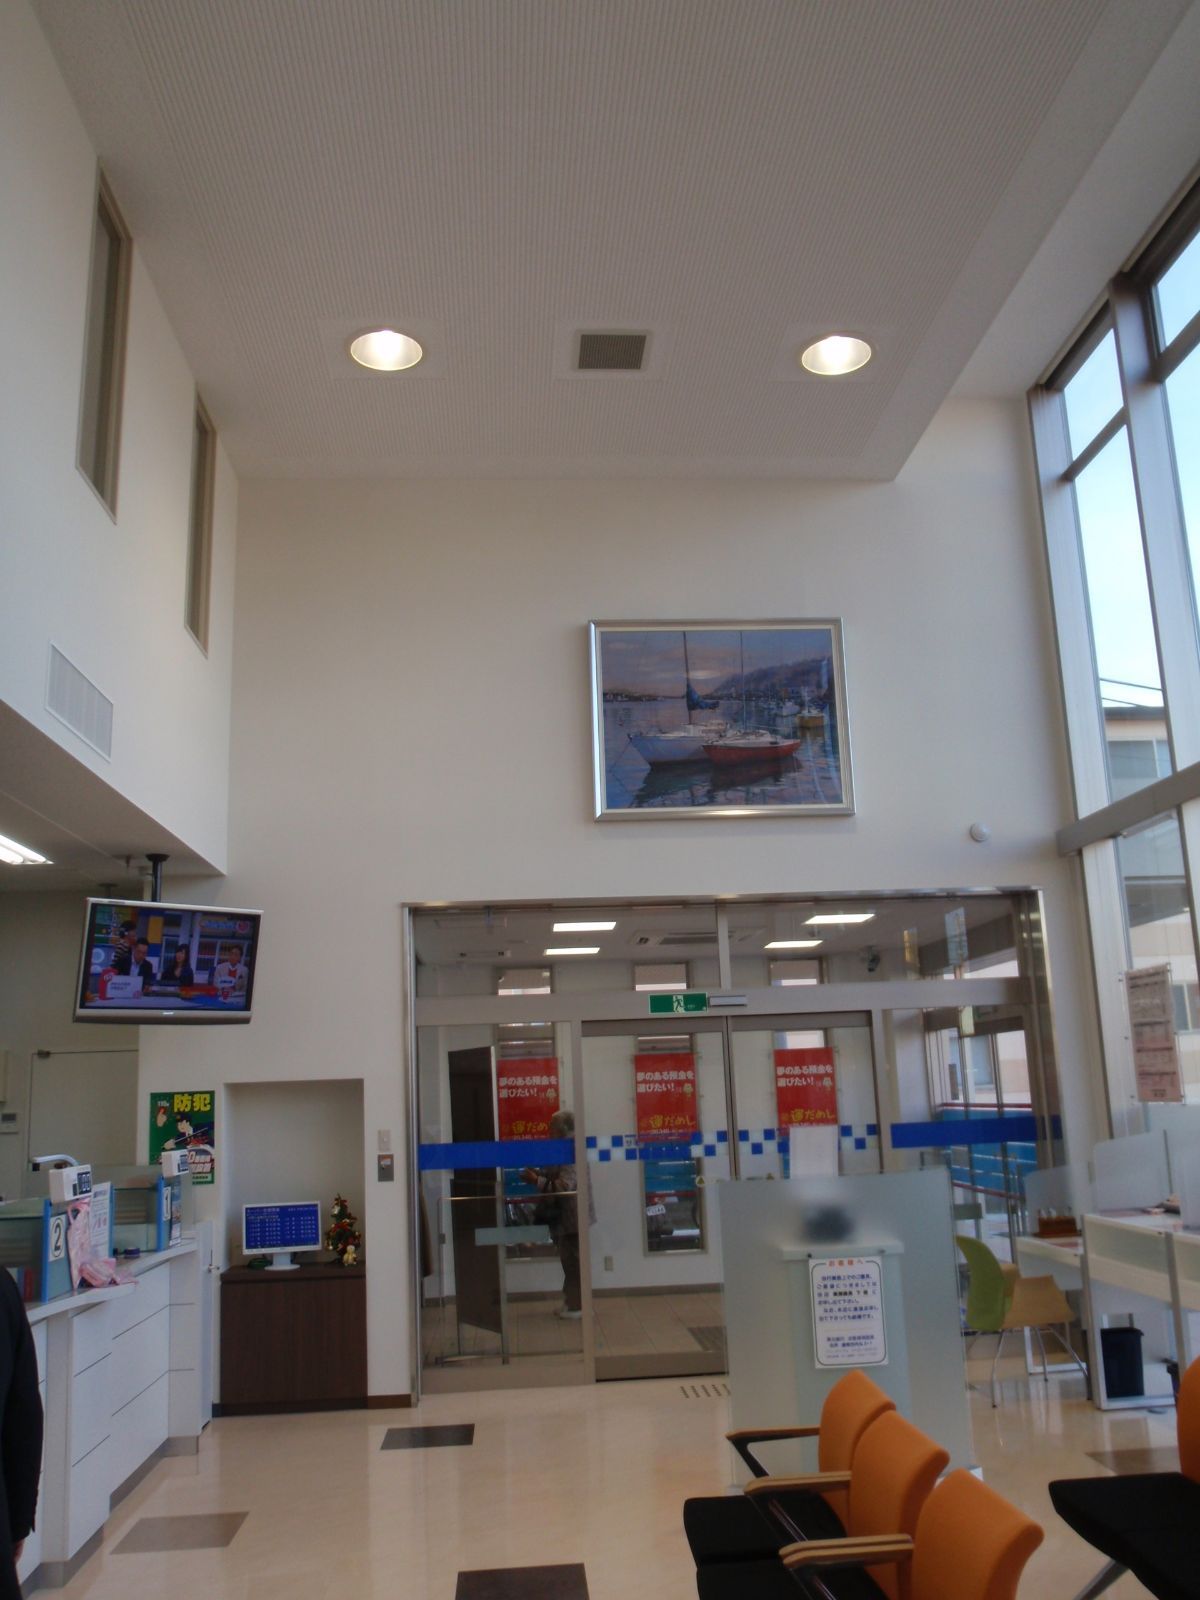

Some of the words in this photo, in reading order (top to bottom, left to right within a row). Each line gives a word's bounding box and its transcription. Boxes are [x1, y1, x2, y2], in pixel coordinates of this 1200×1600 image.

[173, 1093, 211, 1112] 防犯
[512, 1120, 548, 1133] 運だめ
[53, 1221, 61, 1251] 2
